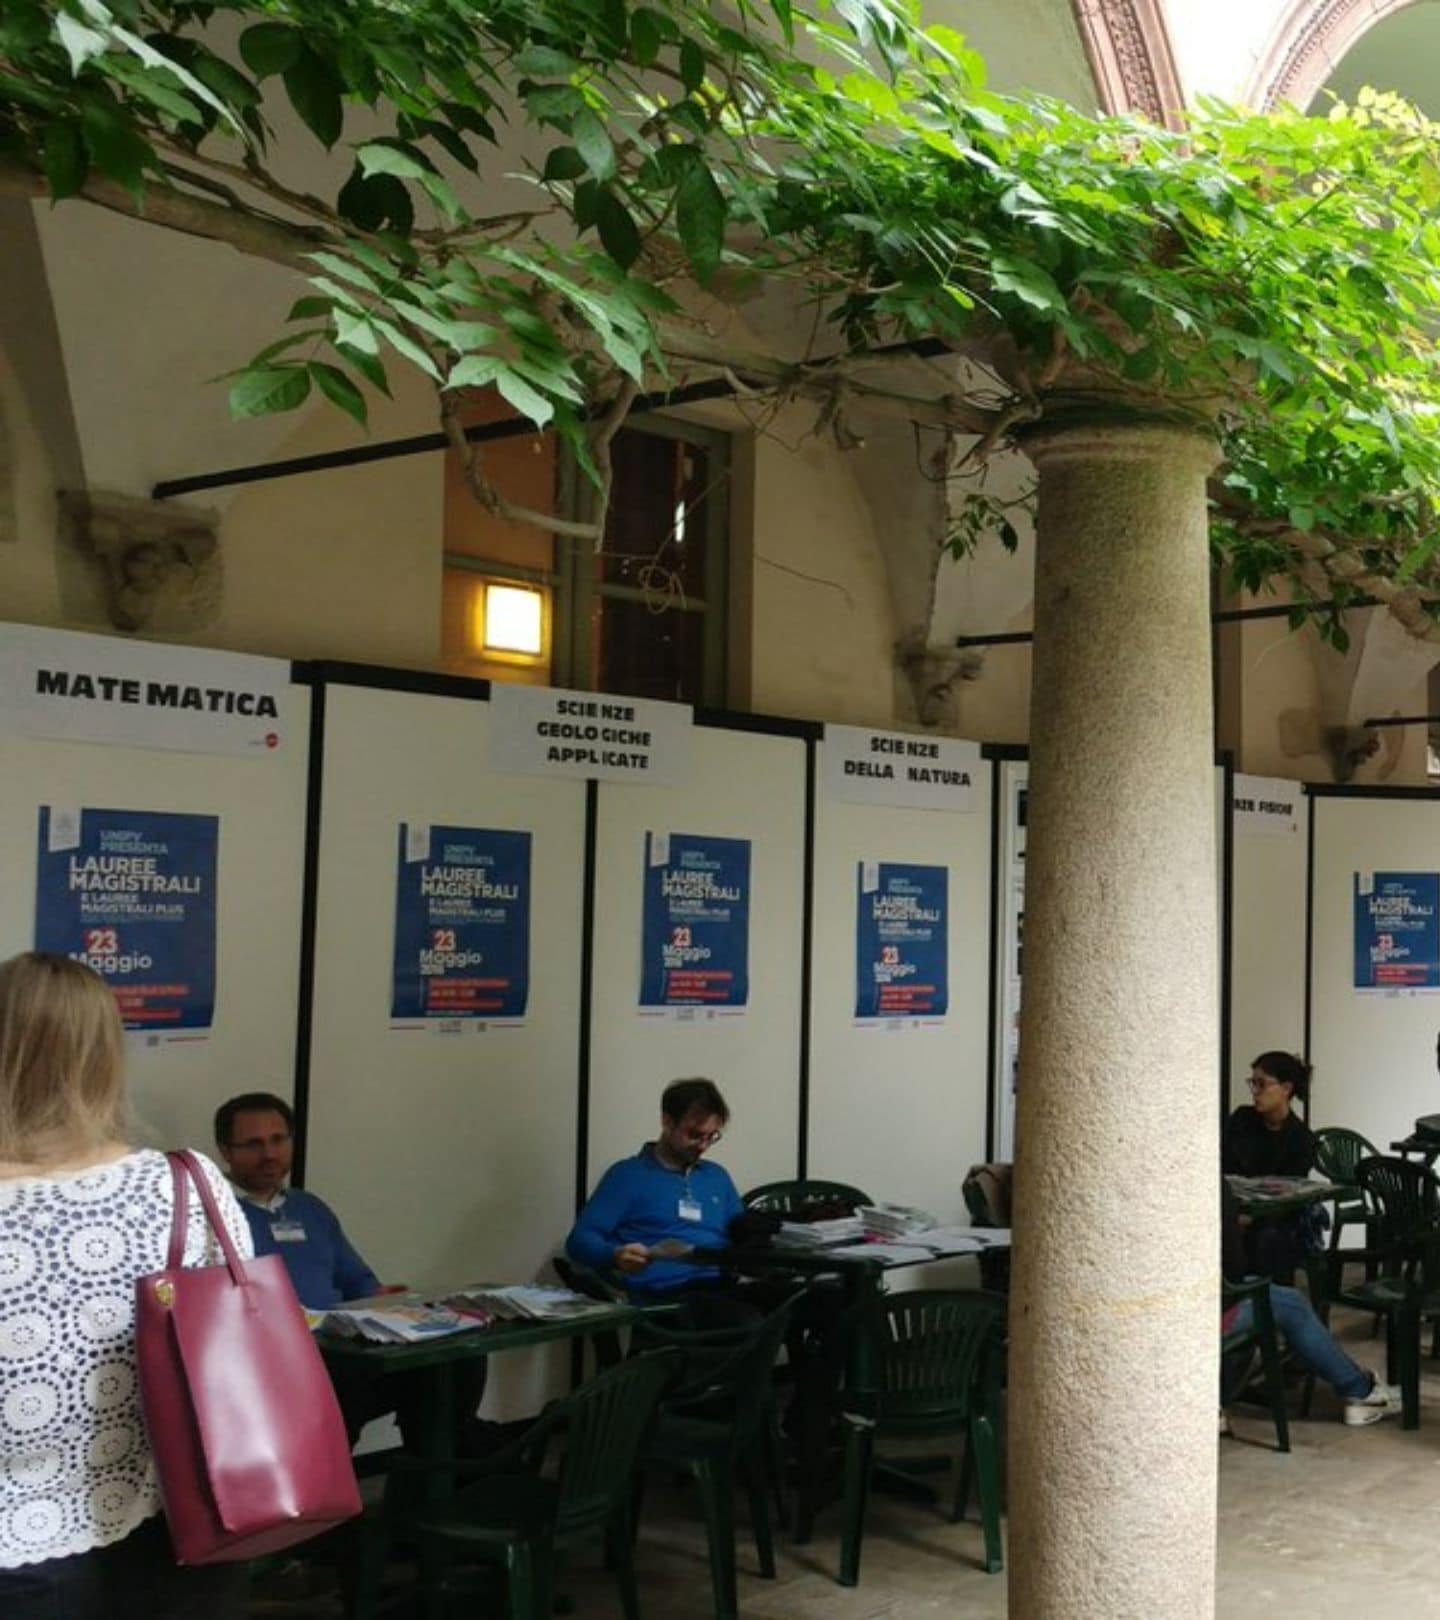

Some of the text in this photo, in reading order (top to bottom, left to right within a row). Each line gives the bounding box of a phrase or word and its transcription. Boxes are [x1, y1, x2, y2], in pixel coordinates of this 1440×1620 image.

[36, 669, 279, 718] MATEMATICA
[557, 700, 635, 721] SCIENZE
[537, 722, 651, 746] GEOLOGICHE
[547, 746, 649, 769] APPLICATE
[871, 737, 939, 759] SCIENZE
[844, 760, 971, 787] DELLA NATURA
[69, 856, 157, 875] LAUREE
[421, 866, 486, 884] LAUREE
[69, 873, 201, 893] MAGISTRALI
[662, 870, 714, 885] LAUREE
[421, 880, 519, 899] MAGISTRALI
[662, 880, 740, 900] MAGISTRALI
[88, 930, 118, 954] 23
[434, 929, 456, 952] 23
[673, 927, 691, 947] 23
[420, 948, 483, 968] Maggio
[662, 944, 711, 962] Maggio
[882, 945, 899, 964] 23
